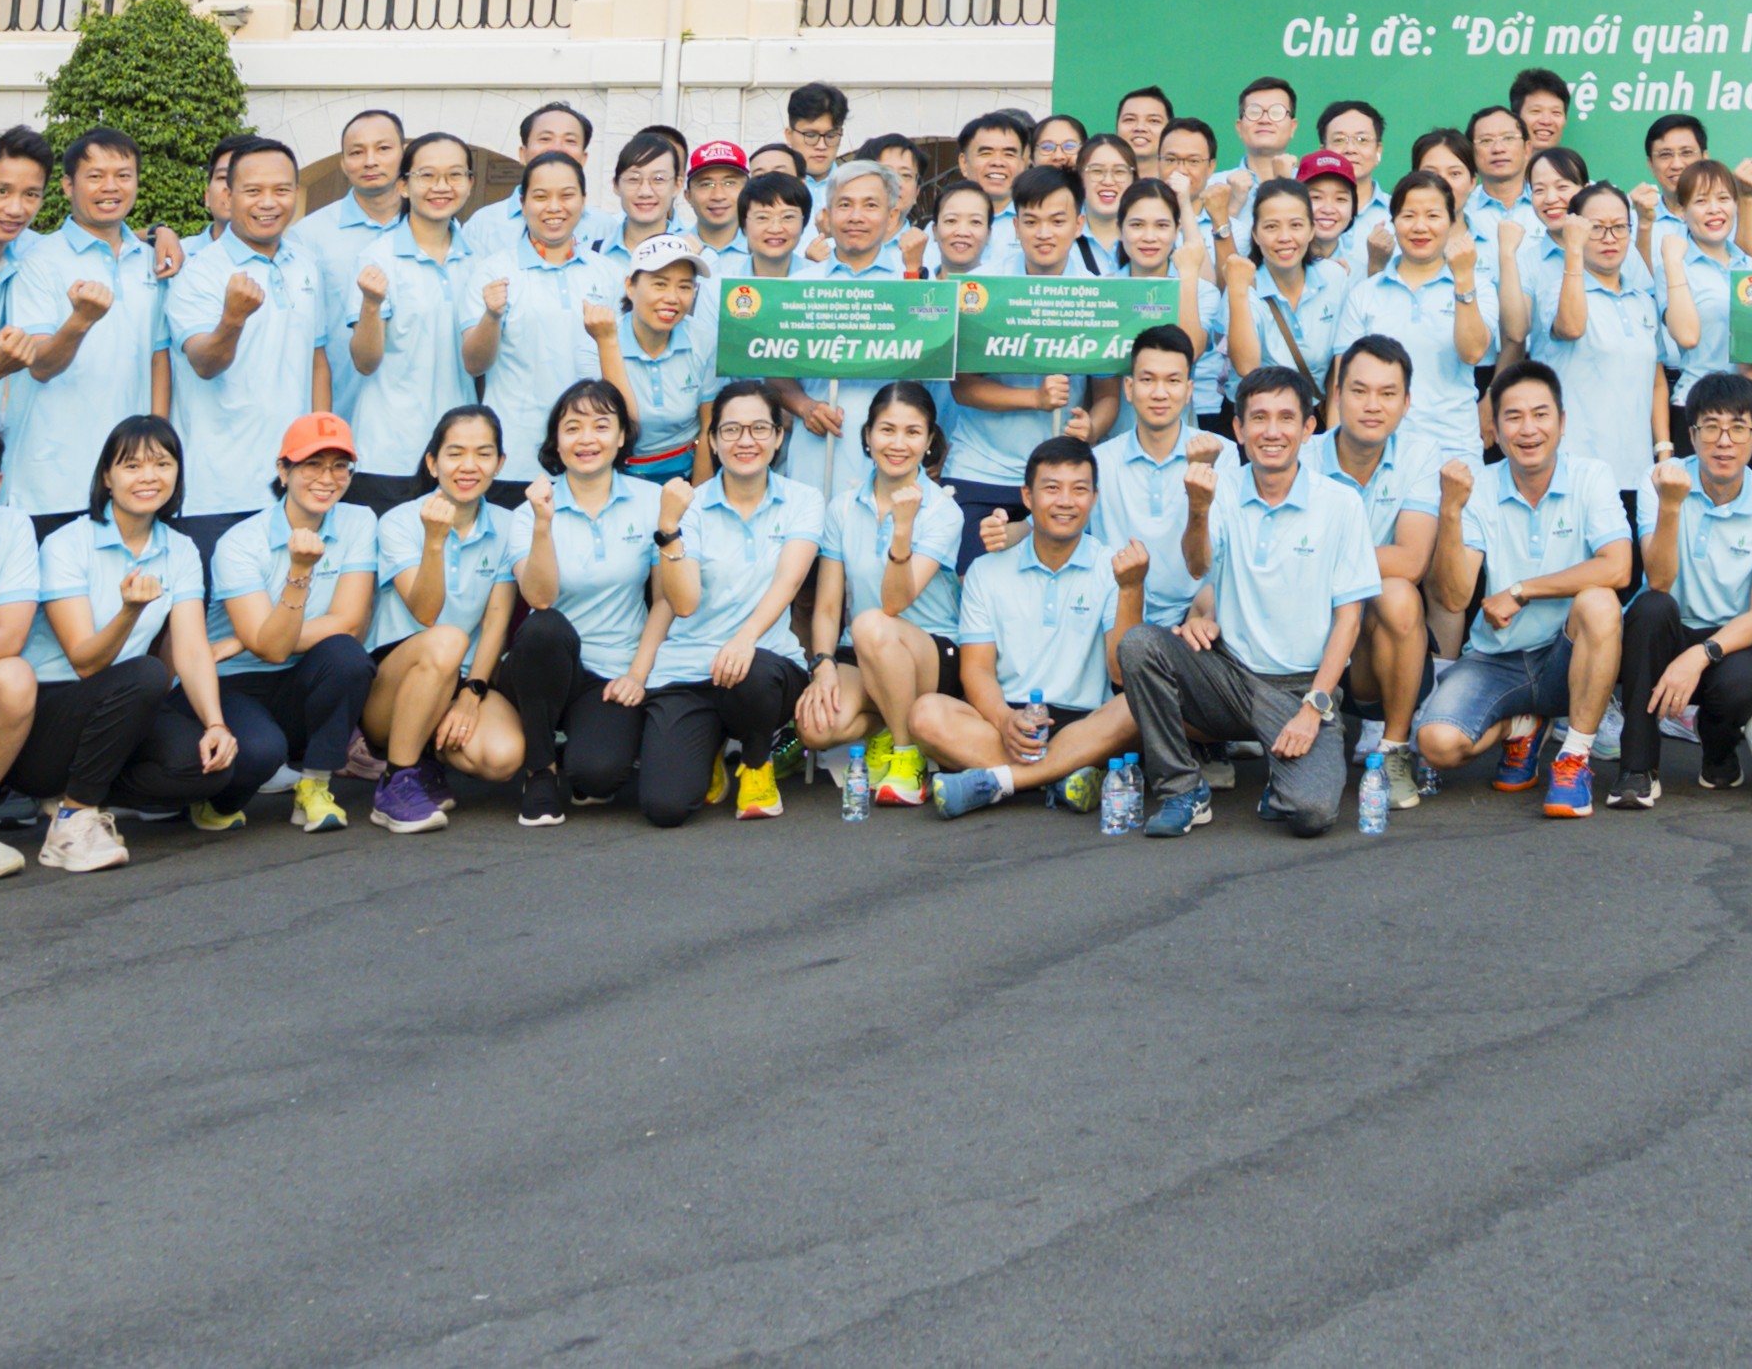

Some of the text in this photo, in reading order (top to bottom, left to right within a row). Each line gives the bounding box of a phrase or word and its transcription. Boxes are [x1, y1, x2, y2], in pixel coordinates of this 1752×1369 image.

[1282, 13, 1359, 57] Chủ
[1370, 13, 1436, 57] đề:
[1452, 12, 1535, 56] “Đổi
[1544, 14, 1622, 55] mới
[1632, 10, 1729, 64] quản
[1609, 72, 1695, 112] sinh
[748, 334, 924, 364] CNG VIỆT NAM
[984, 333, 1032, 356] KHÍ
[1033, 332, 1098, 359] THẤP
